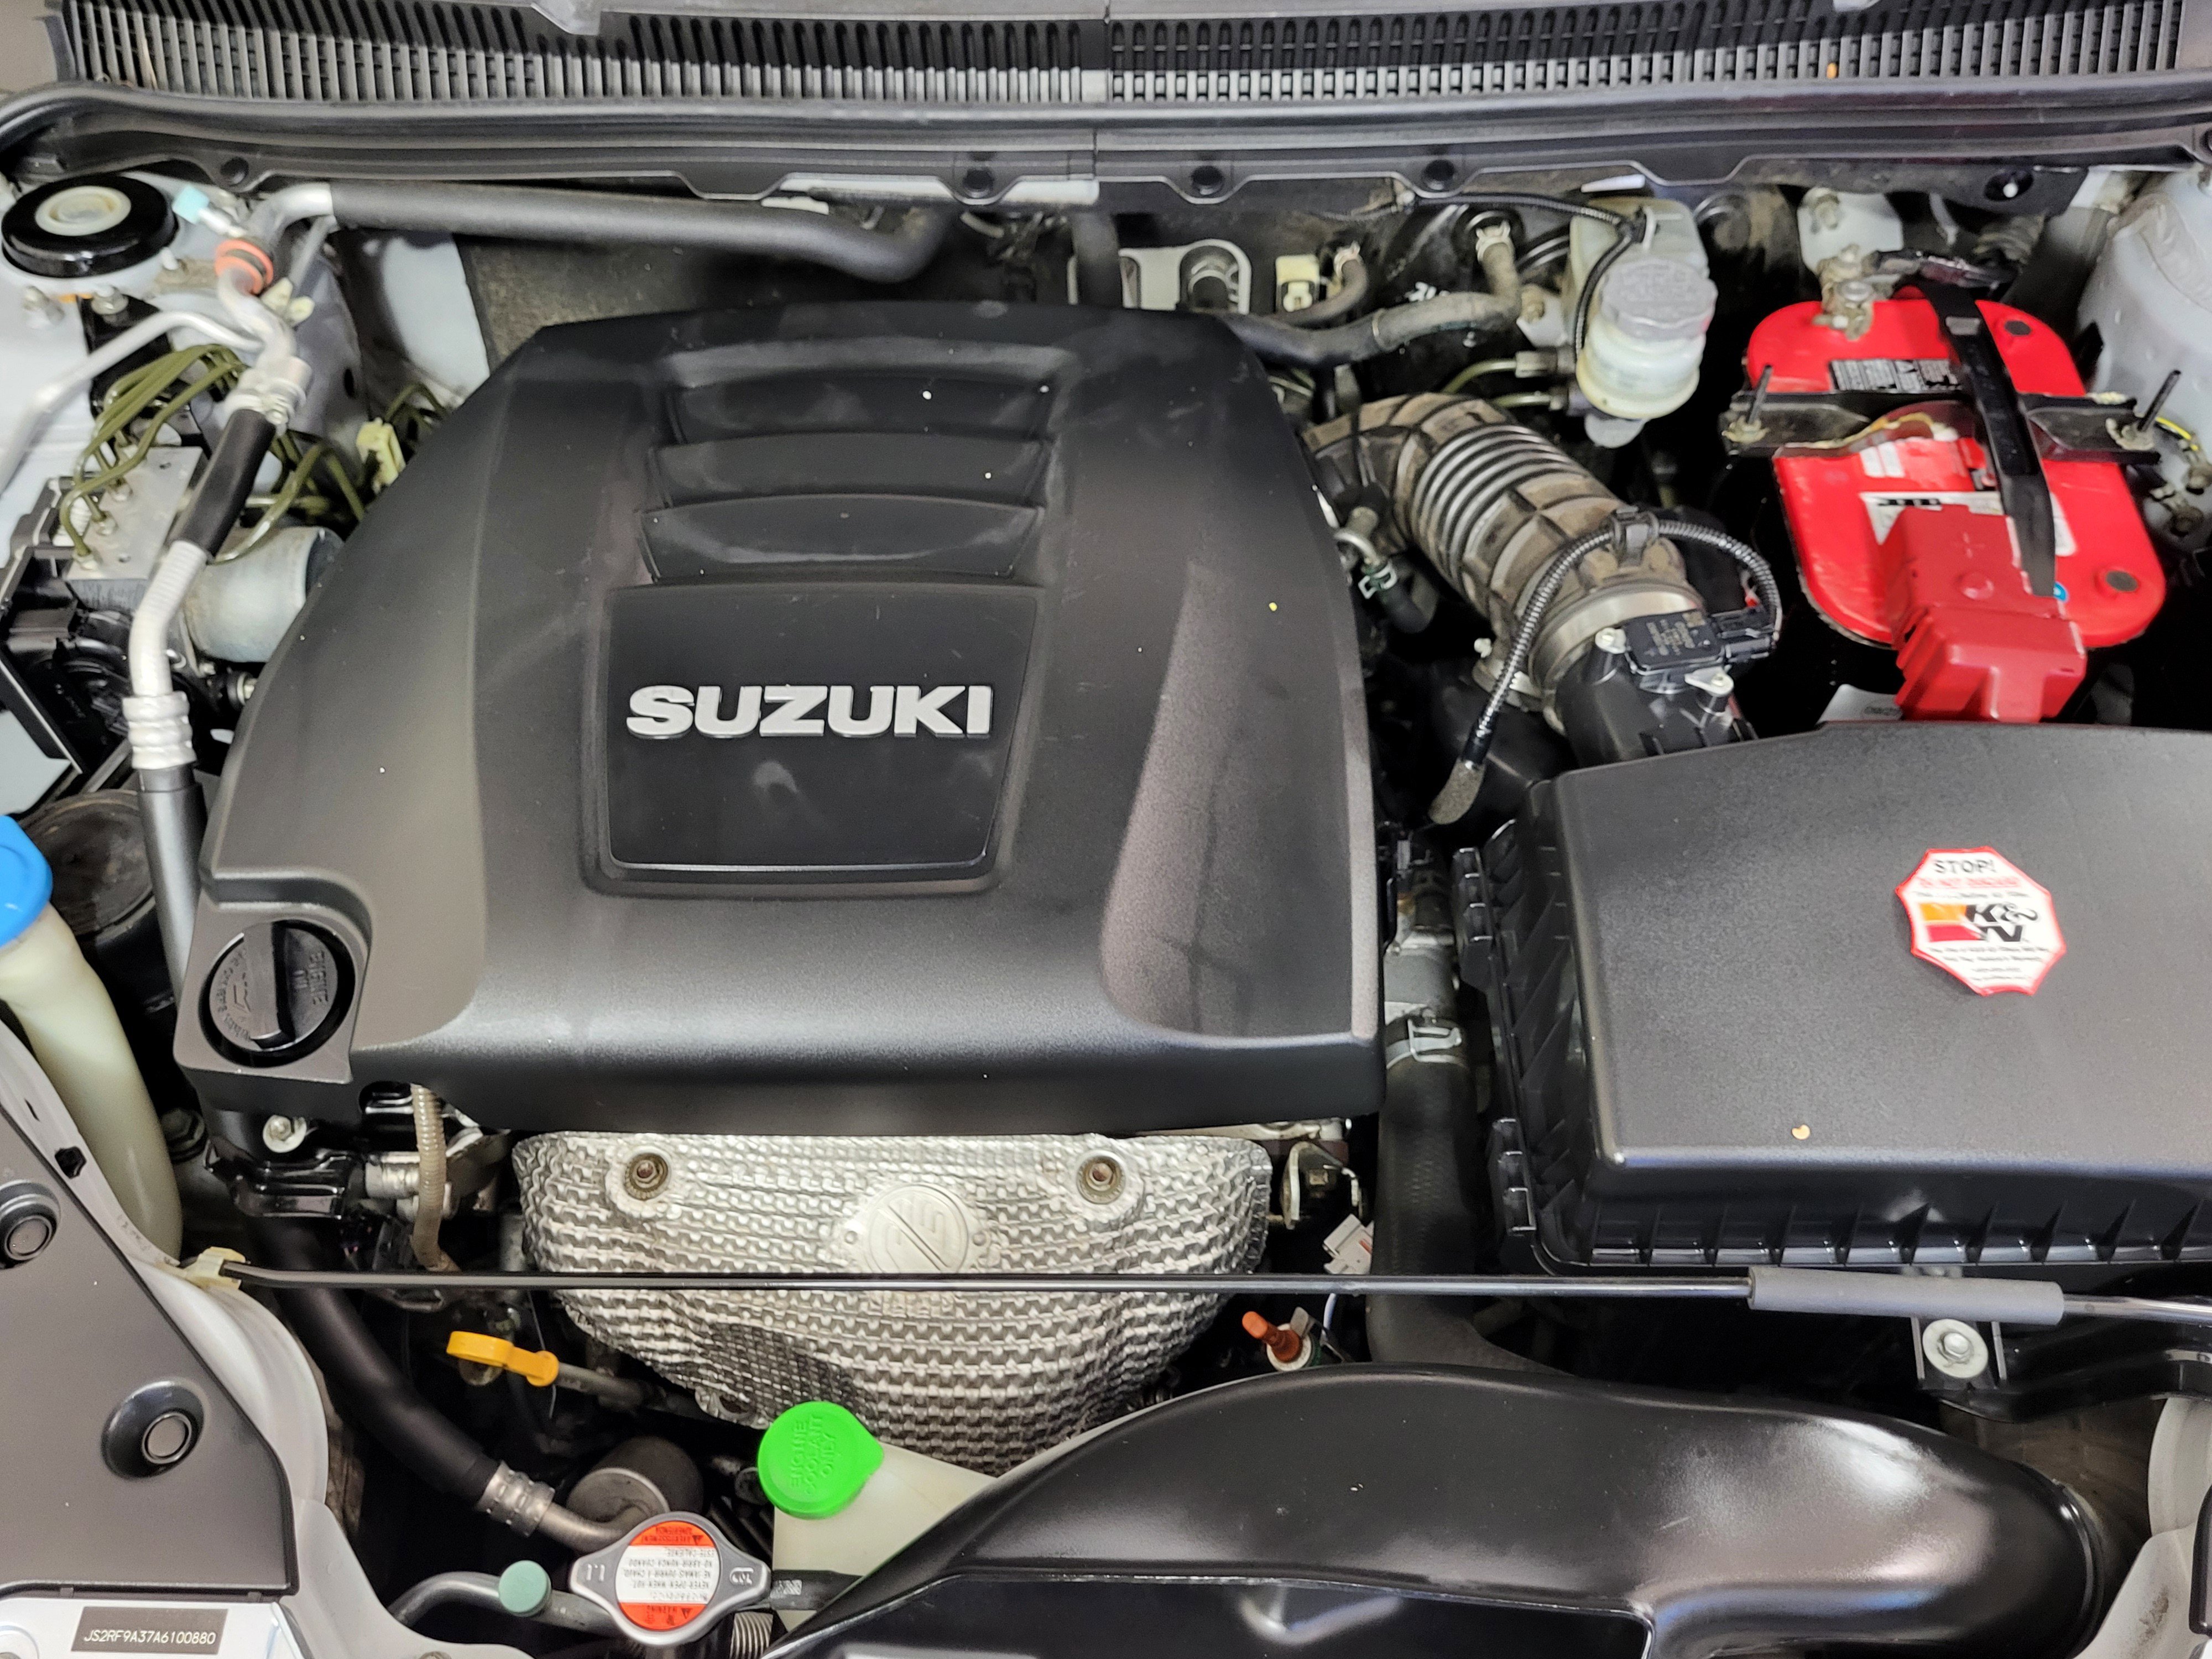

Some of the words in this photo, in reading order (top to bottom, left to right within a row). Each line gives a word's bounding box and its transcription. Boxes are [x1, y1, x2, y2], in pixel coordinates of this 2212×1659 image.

[626, 685, 993, 739] SUZUKI
[1934, 859, 1996, 874] STOP!
[309, 950, 328, 1006] ENGINE
[790, 1421, 807, 1488] ENGINE
[804, 1414, 822, 1495] COOLANT
[820, 1432, 836, 1479] ONLY
[84, 1629, 217, 1645] JS2RF9A37A6100880
